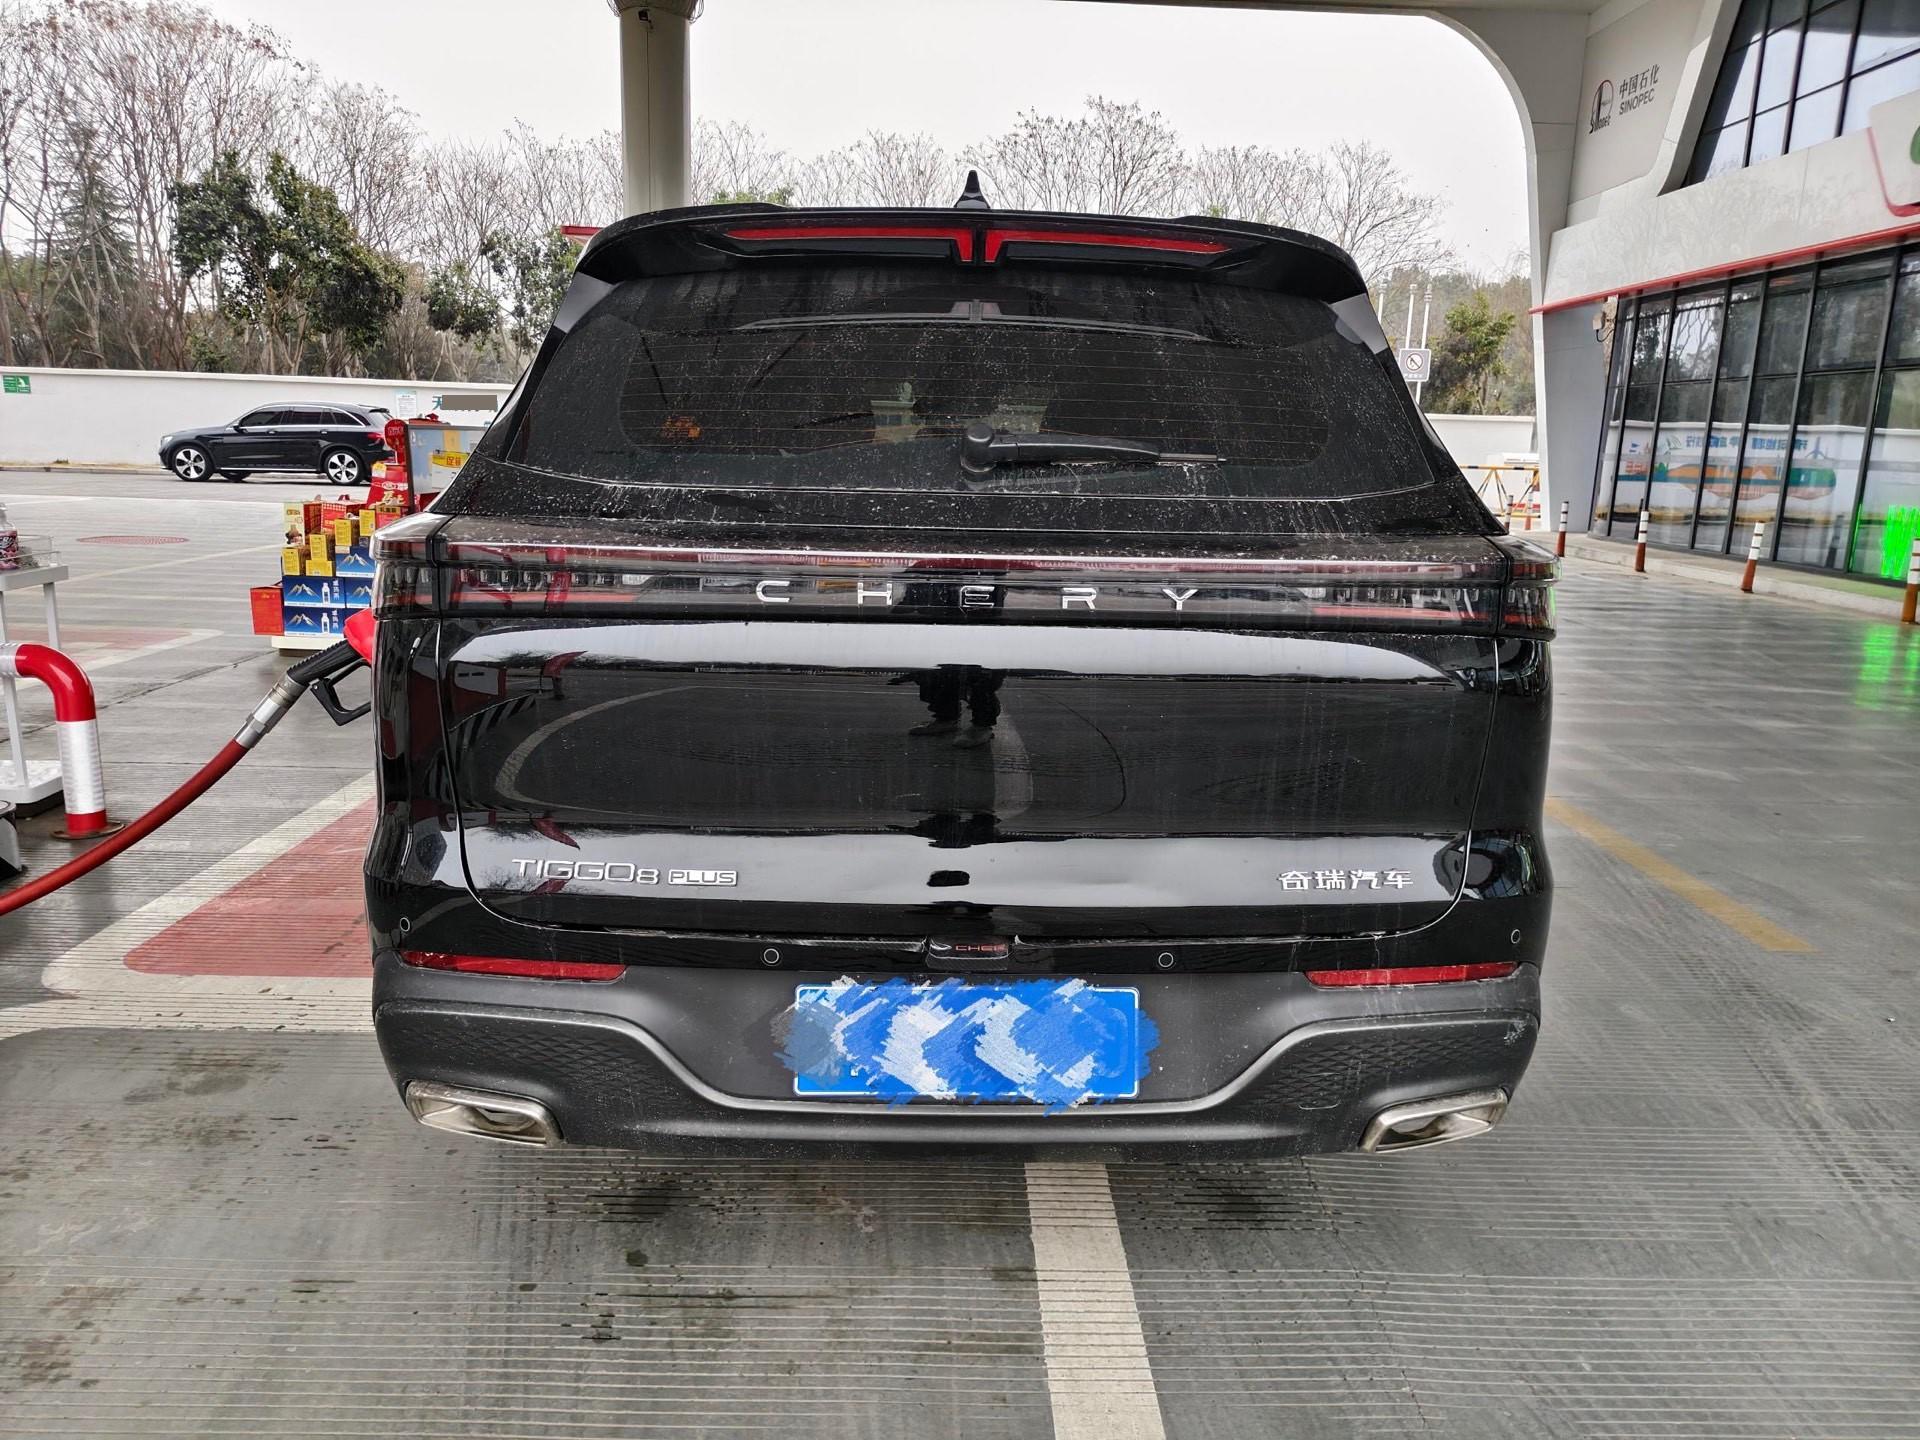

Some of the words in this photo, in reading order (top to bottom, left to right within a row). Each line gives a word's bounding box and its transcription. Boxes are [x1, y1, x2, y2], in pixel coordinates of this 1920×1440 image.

[1619, 64, 1660, 99] 中国石化
[1619, 88, 1655, 115] SINOPEC
[755, 580, 1199, 611] CHERY
[668, 869, 737, 886] PLUS
[1278, 869, 1414, 891] 奇瑞汽车
